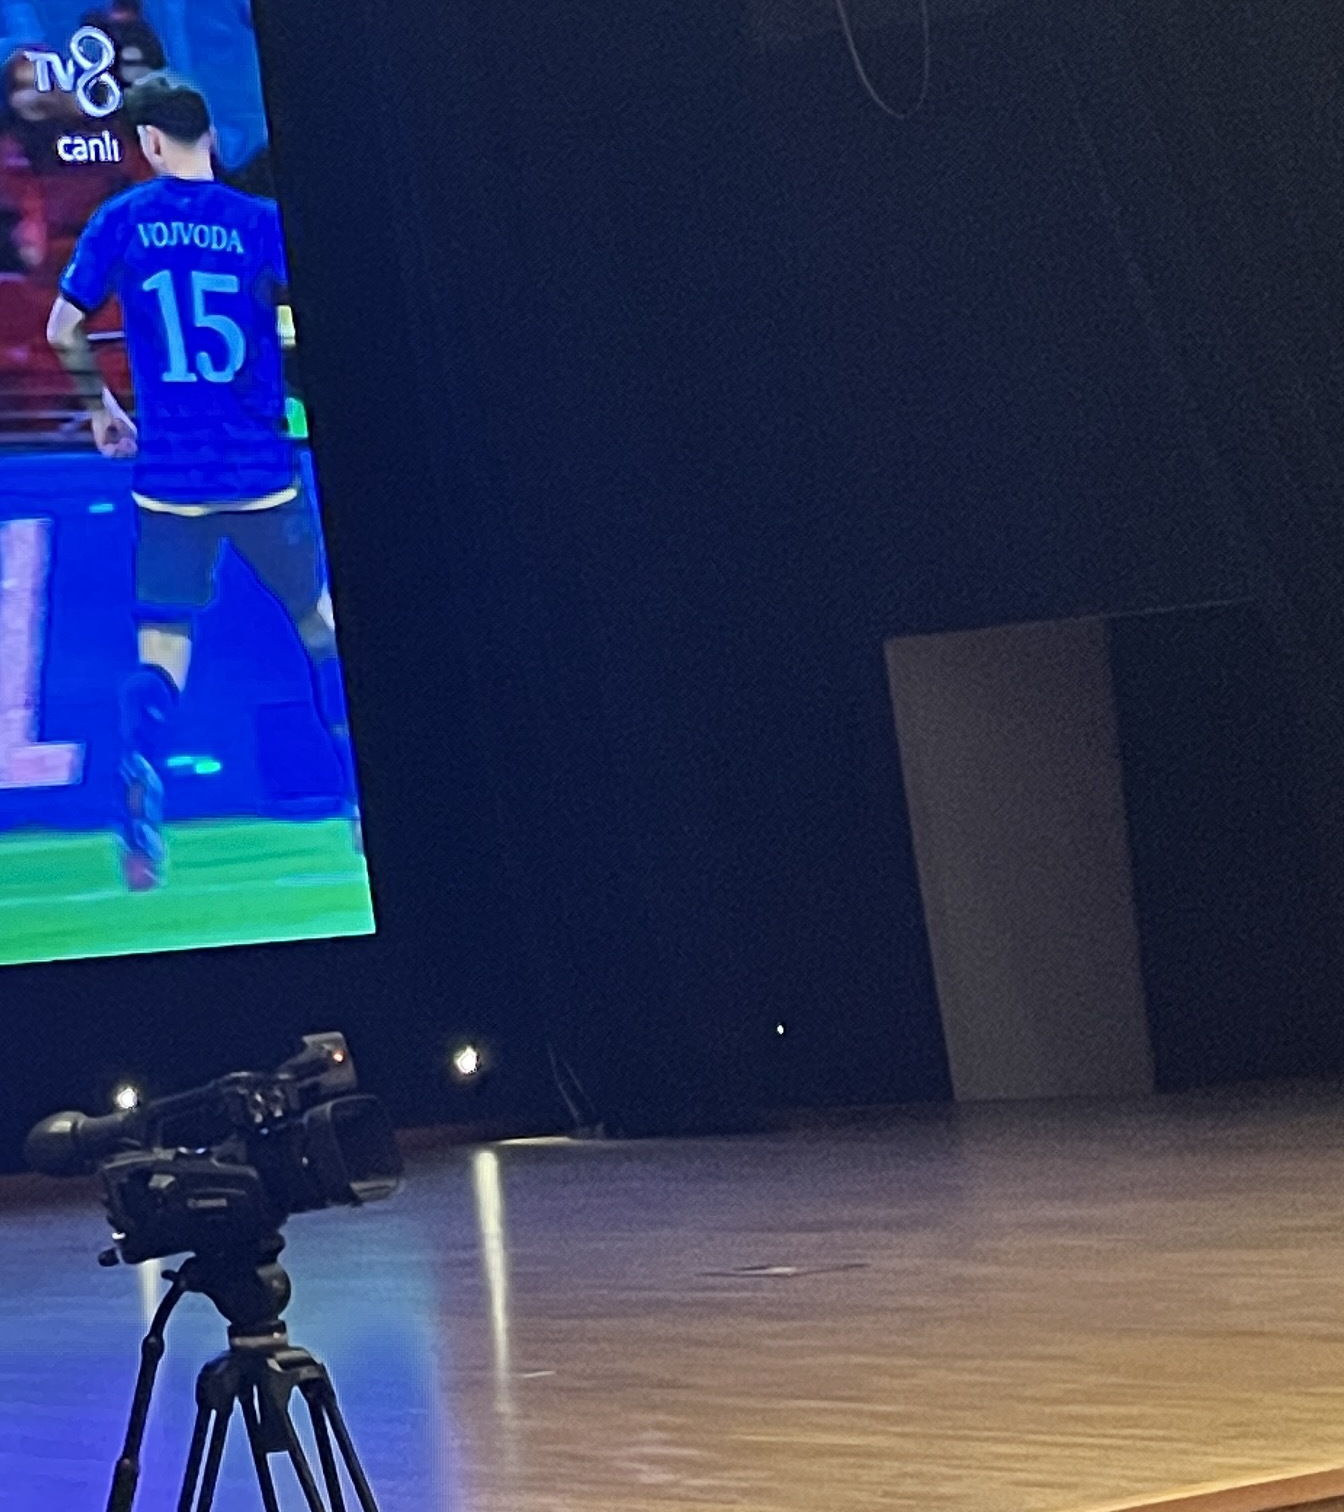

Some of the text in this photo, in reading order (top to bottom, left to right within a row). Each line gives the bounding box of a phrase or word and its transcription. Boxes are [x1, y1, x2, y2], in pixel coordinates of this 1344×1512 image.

[57, 131, 122, 163] canlı
[138, 221, 244, 254] VOJVODA
[142, 269, 247, 384] 15
